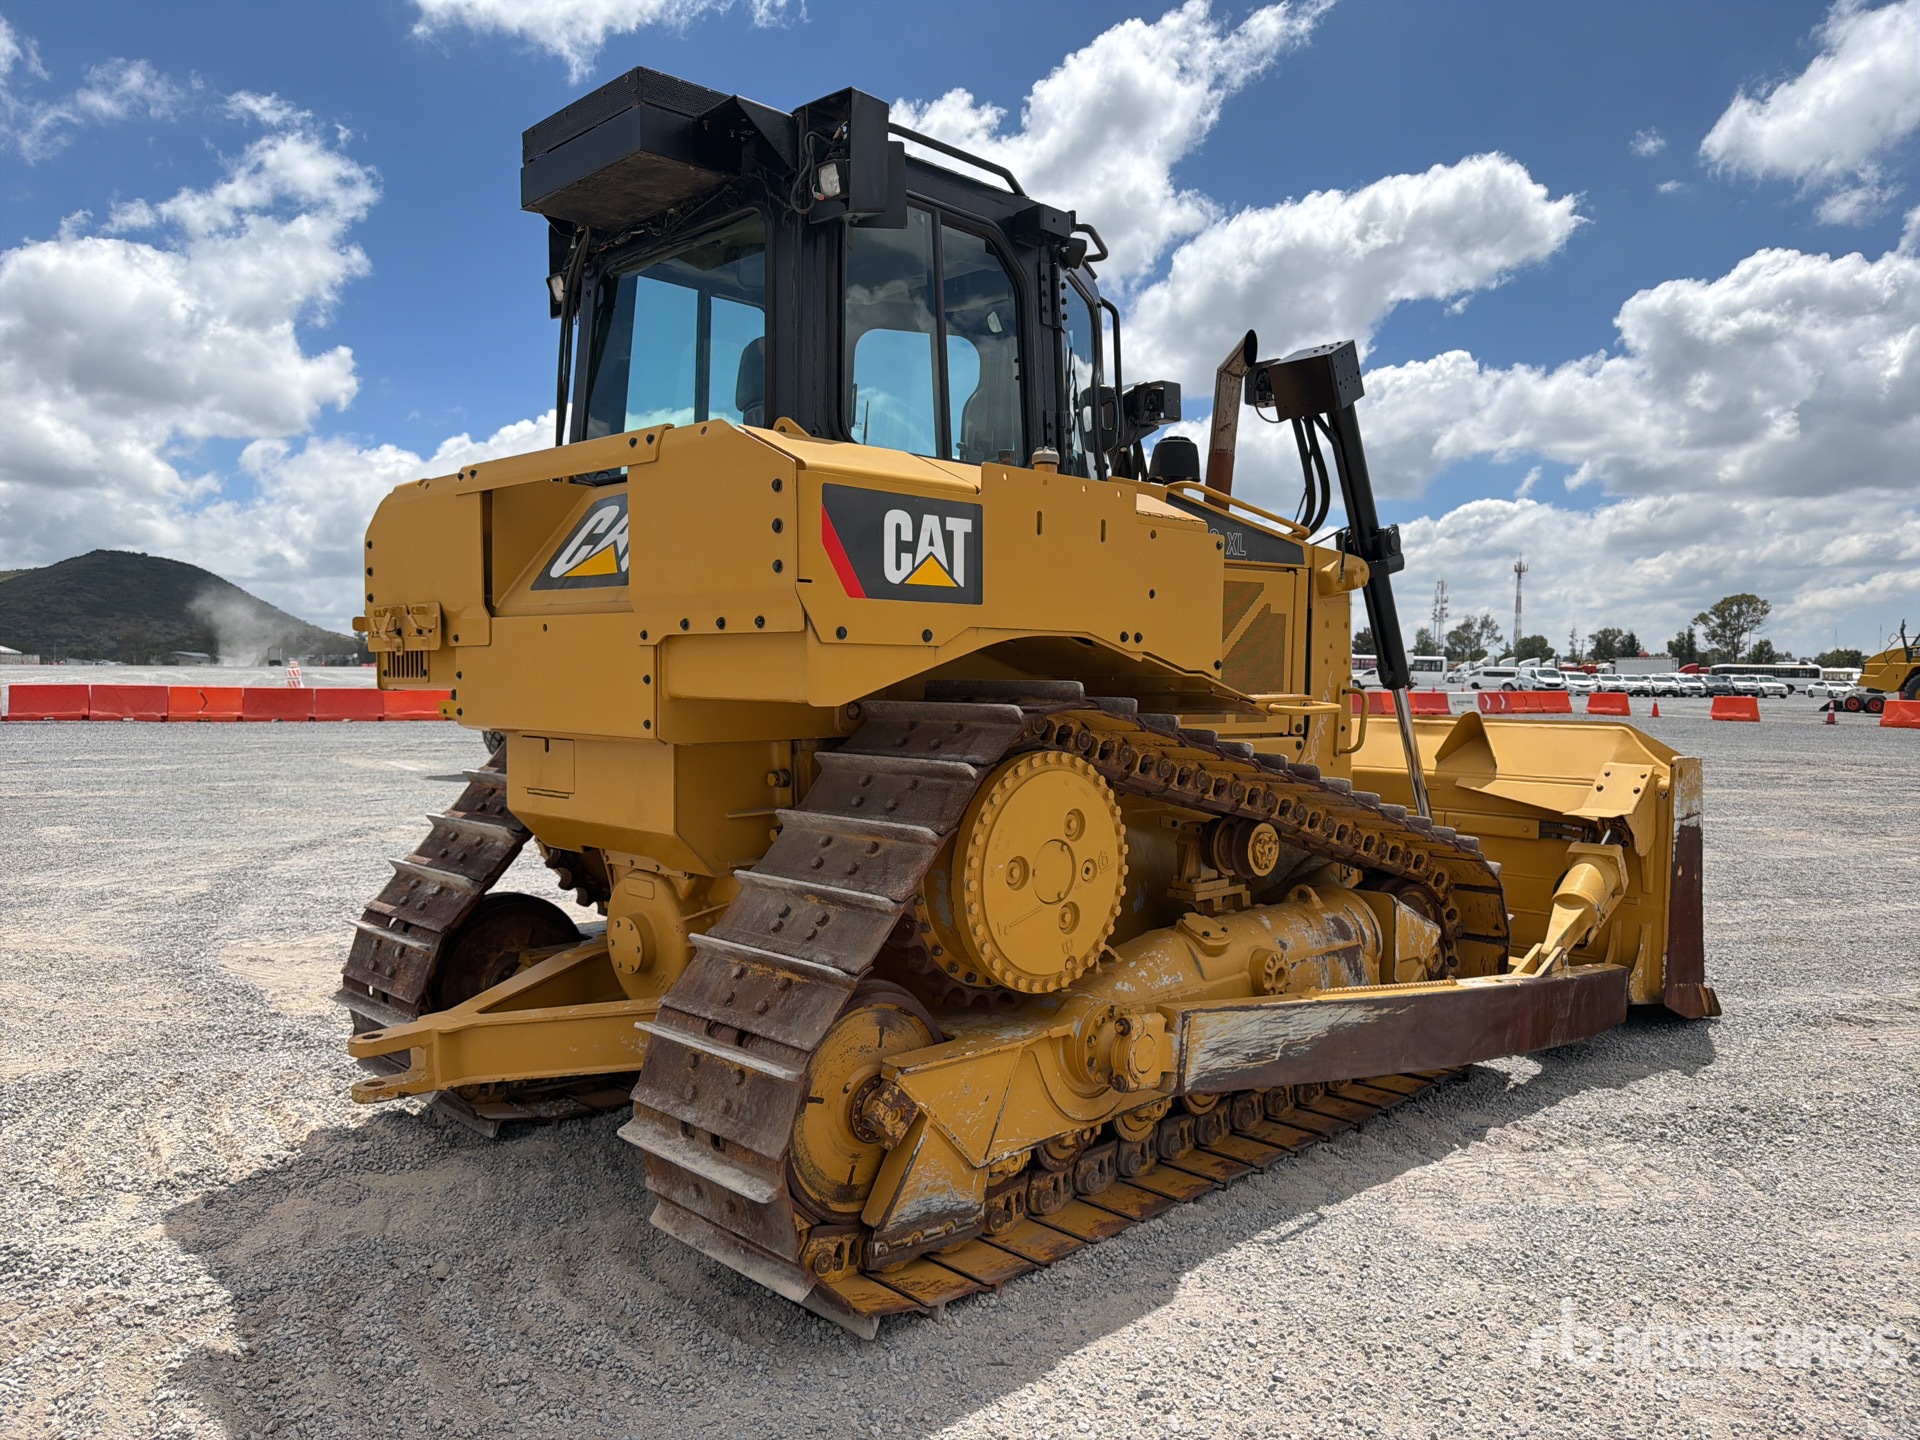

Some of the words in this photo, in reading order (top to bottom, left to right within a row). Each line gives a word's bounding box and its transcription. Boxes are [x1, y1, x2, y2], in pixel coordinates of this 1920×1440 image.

[549, 505, 629, 578] CA
[884, 509, 972, 588] CAT
[1226, 532, 1247, 556] XL
